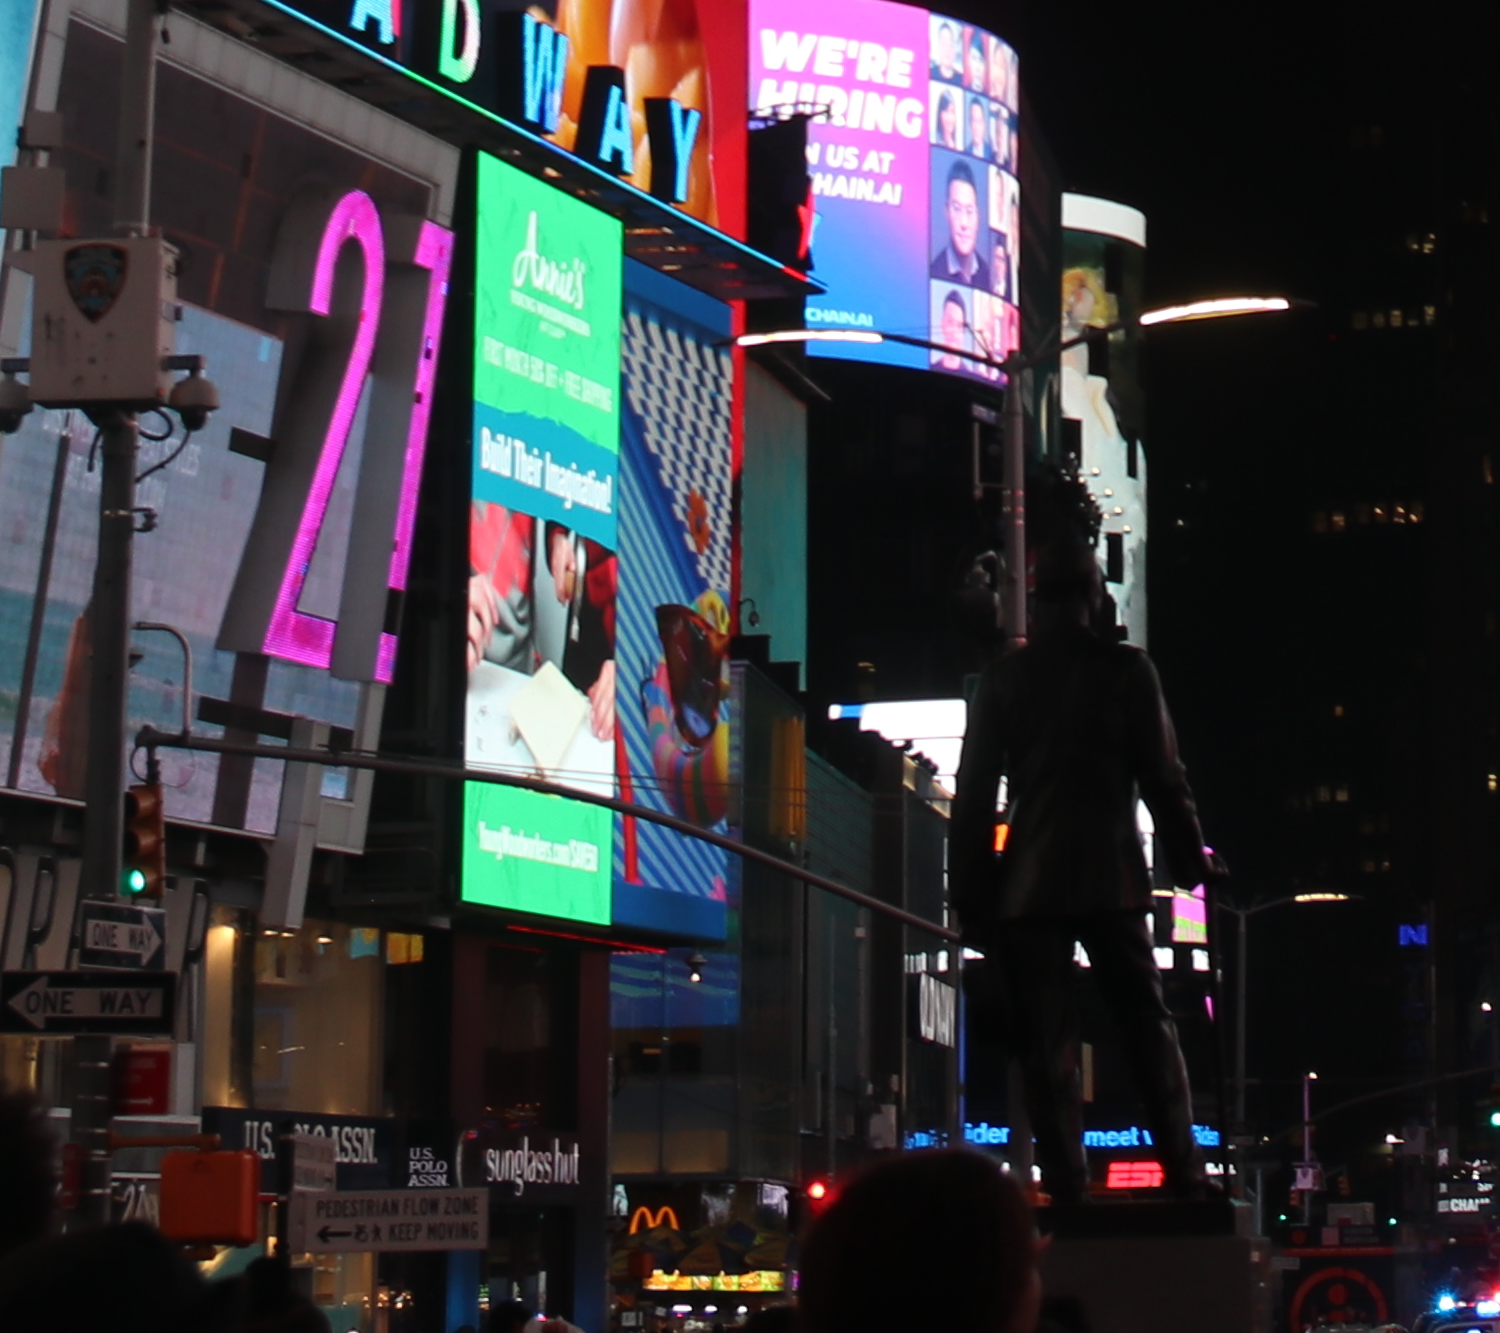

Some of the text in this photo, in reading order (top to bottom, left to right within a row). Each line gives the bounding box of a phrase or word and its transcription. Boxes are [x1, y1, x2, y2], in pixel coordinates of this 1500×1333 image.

[759, 28, 915, 89] WE'RE
[756, 78, 925, 139] HIRING
[825, 143, 859, 171] US
[861, 149, 895, 175] AT
[810, 171, 902, 206] HAIN.AI
[511, 210, 587, 311] Annie's
[262, 189, 455, 684] 21
[480, 426, 613, 514] Build Their Imagination!
[93, 924, 152, 948] ONE WAY
[25, 990, 151, 1015] ONE WAY
[244, 1119, 277, 1160] U.S.
[1083, 1125, 1136, 1149] meet
[408, 1147, 435, 1160] U.S.
[408, 1160, 449, 1174] POLO
[485, 1136, 581, 1196] sunglass hut
[407, 1173, 451, 1187] ASSN.
[316, 1196, 479, 1217] PEDESTRIAN FLOW ZONE
[388, 1221, 479, 1242] KEEP MOVING
